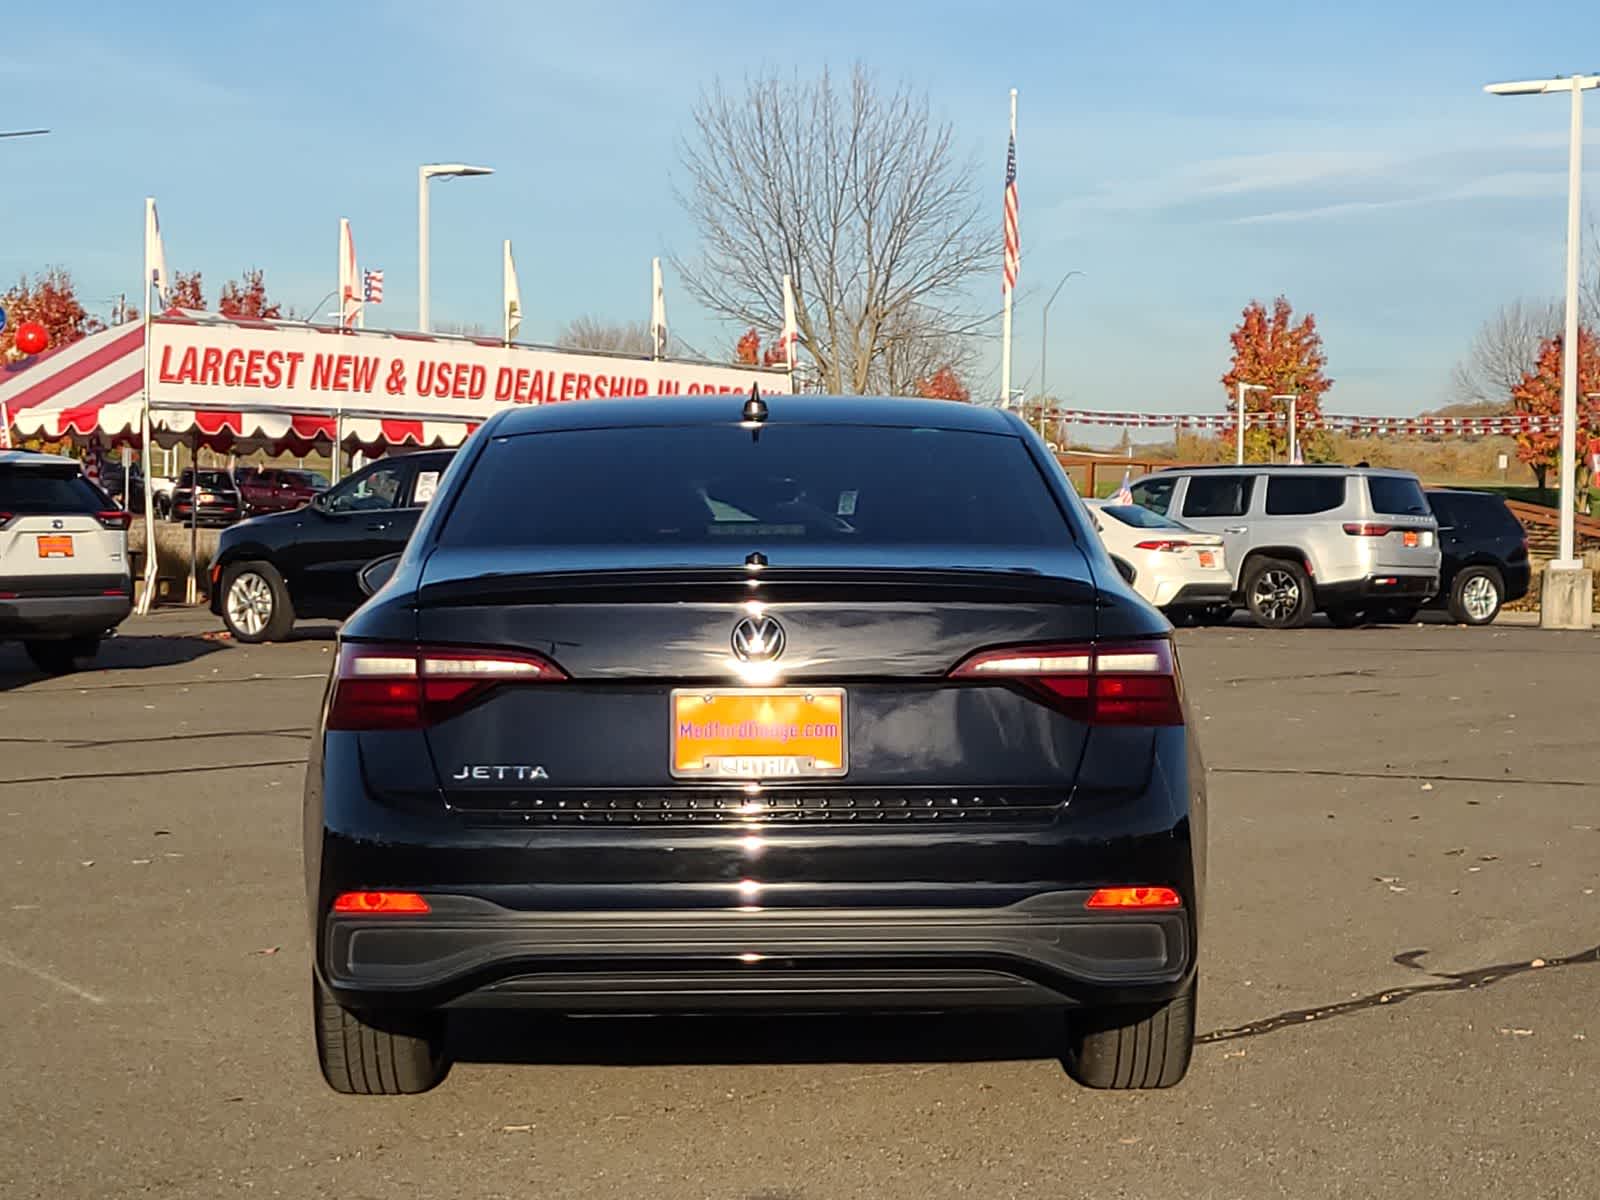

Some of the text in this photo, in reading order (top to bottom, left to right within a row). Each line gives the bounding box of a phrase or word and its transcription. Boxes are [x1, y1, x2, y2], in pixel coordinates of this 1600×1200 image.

[159, 345, 304, 389] LARGEST
[310, 353, 380, 393] NEW
[385, 358, 407, 395] &
[416, 360, 487, 399] USED
[495, 366, 649, 405] DEALERSHIP
[453, 766, 549, 779] JETTA
